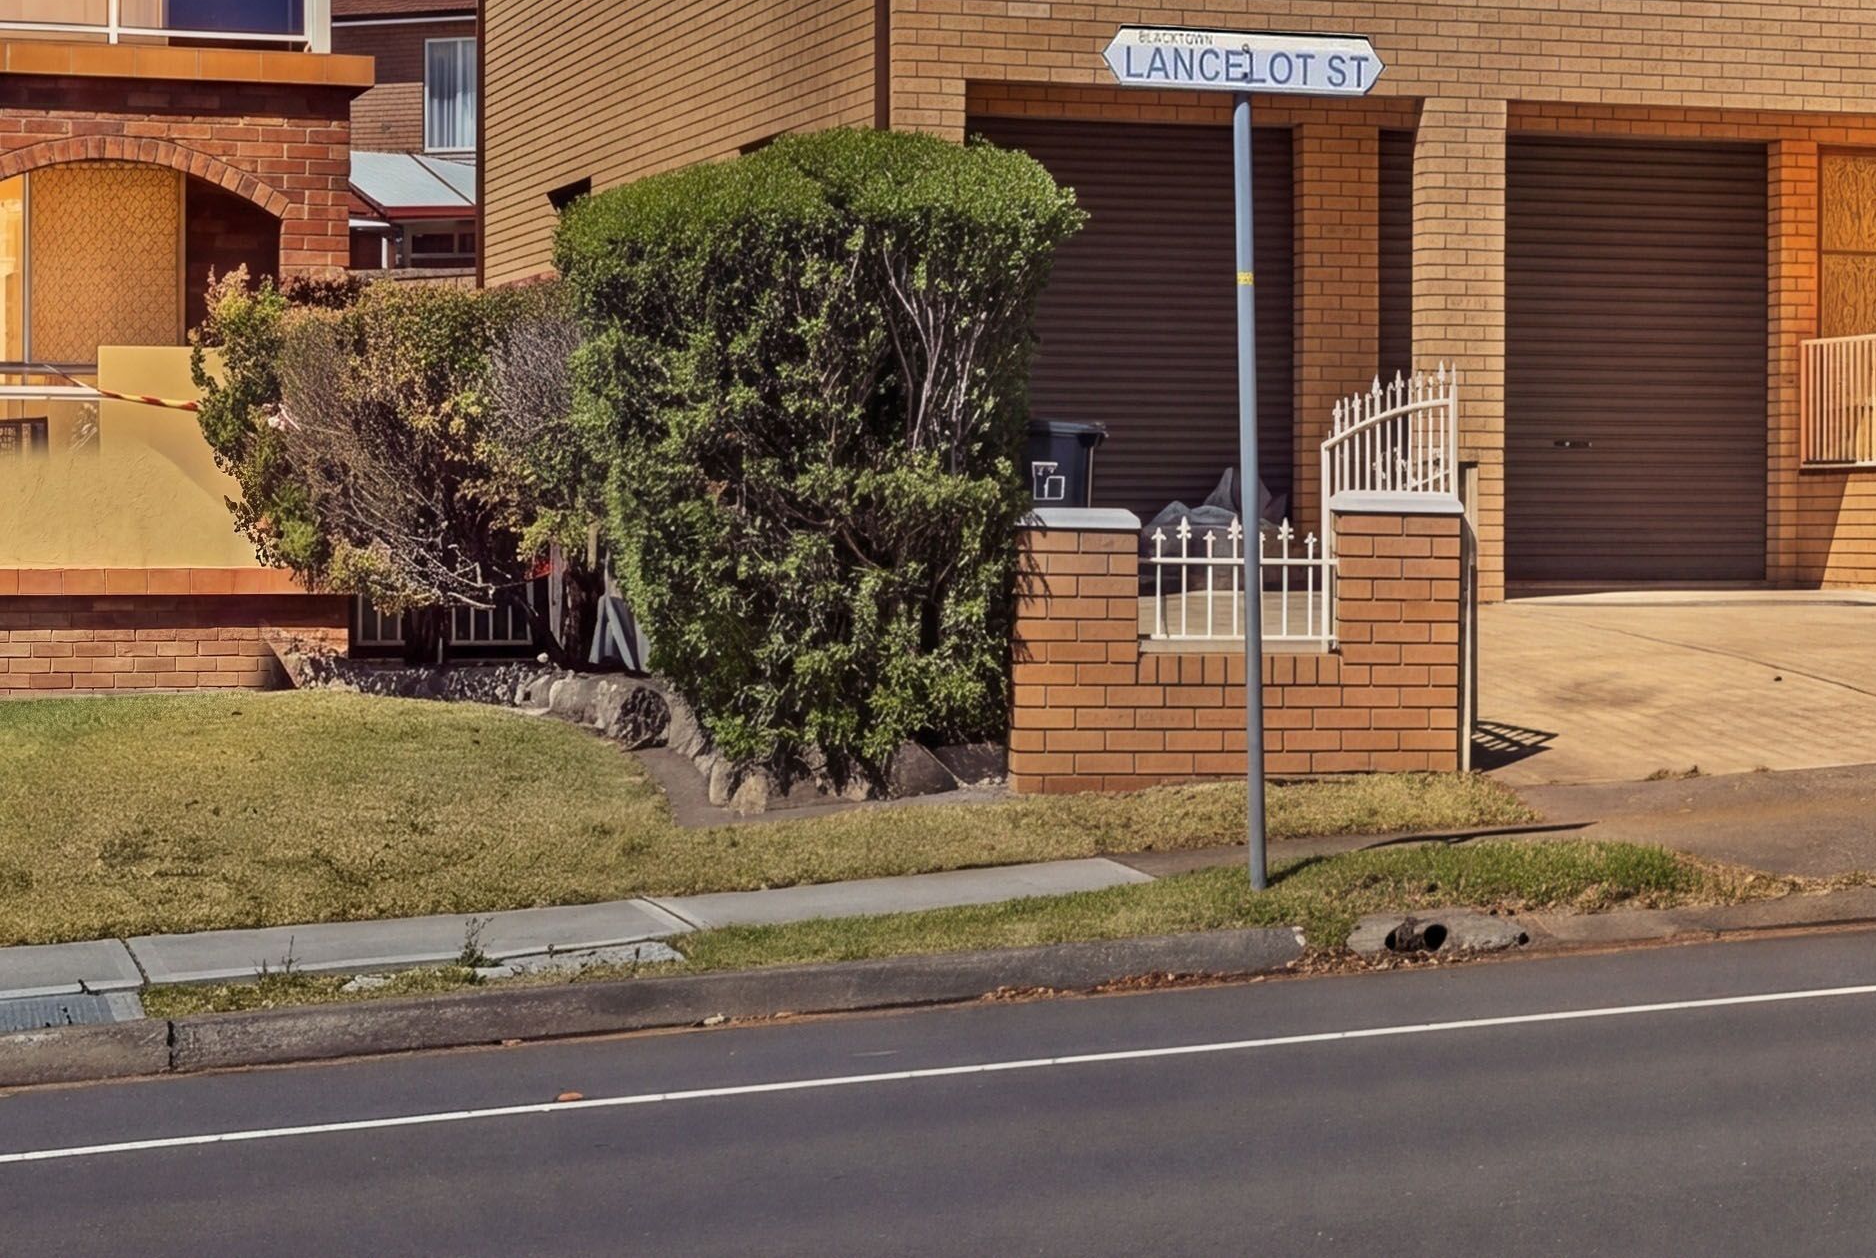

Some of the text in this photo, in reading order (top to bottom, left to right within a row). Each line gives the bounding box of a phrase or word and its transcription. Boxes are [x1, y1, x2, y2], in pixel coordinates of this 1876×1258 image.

[1138, 30, 1214, 46] BLACKTOWN
[1125, 45, 1369, 88] LANCELOT ST
